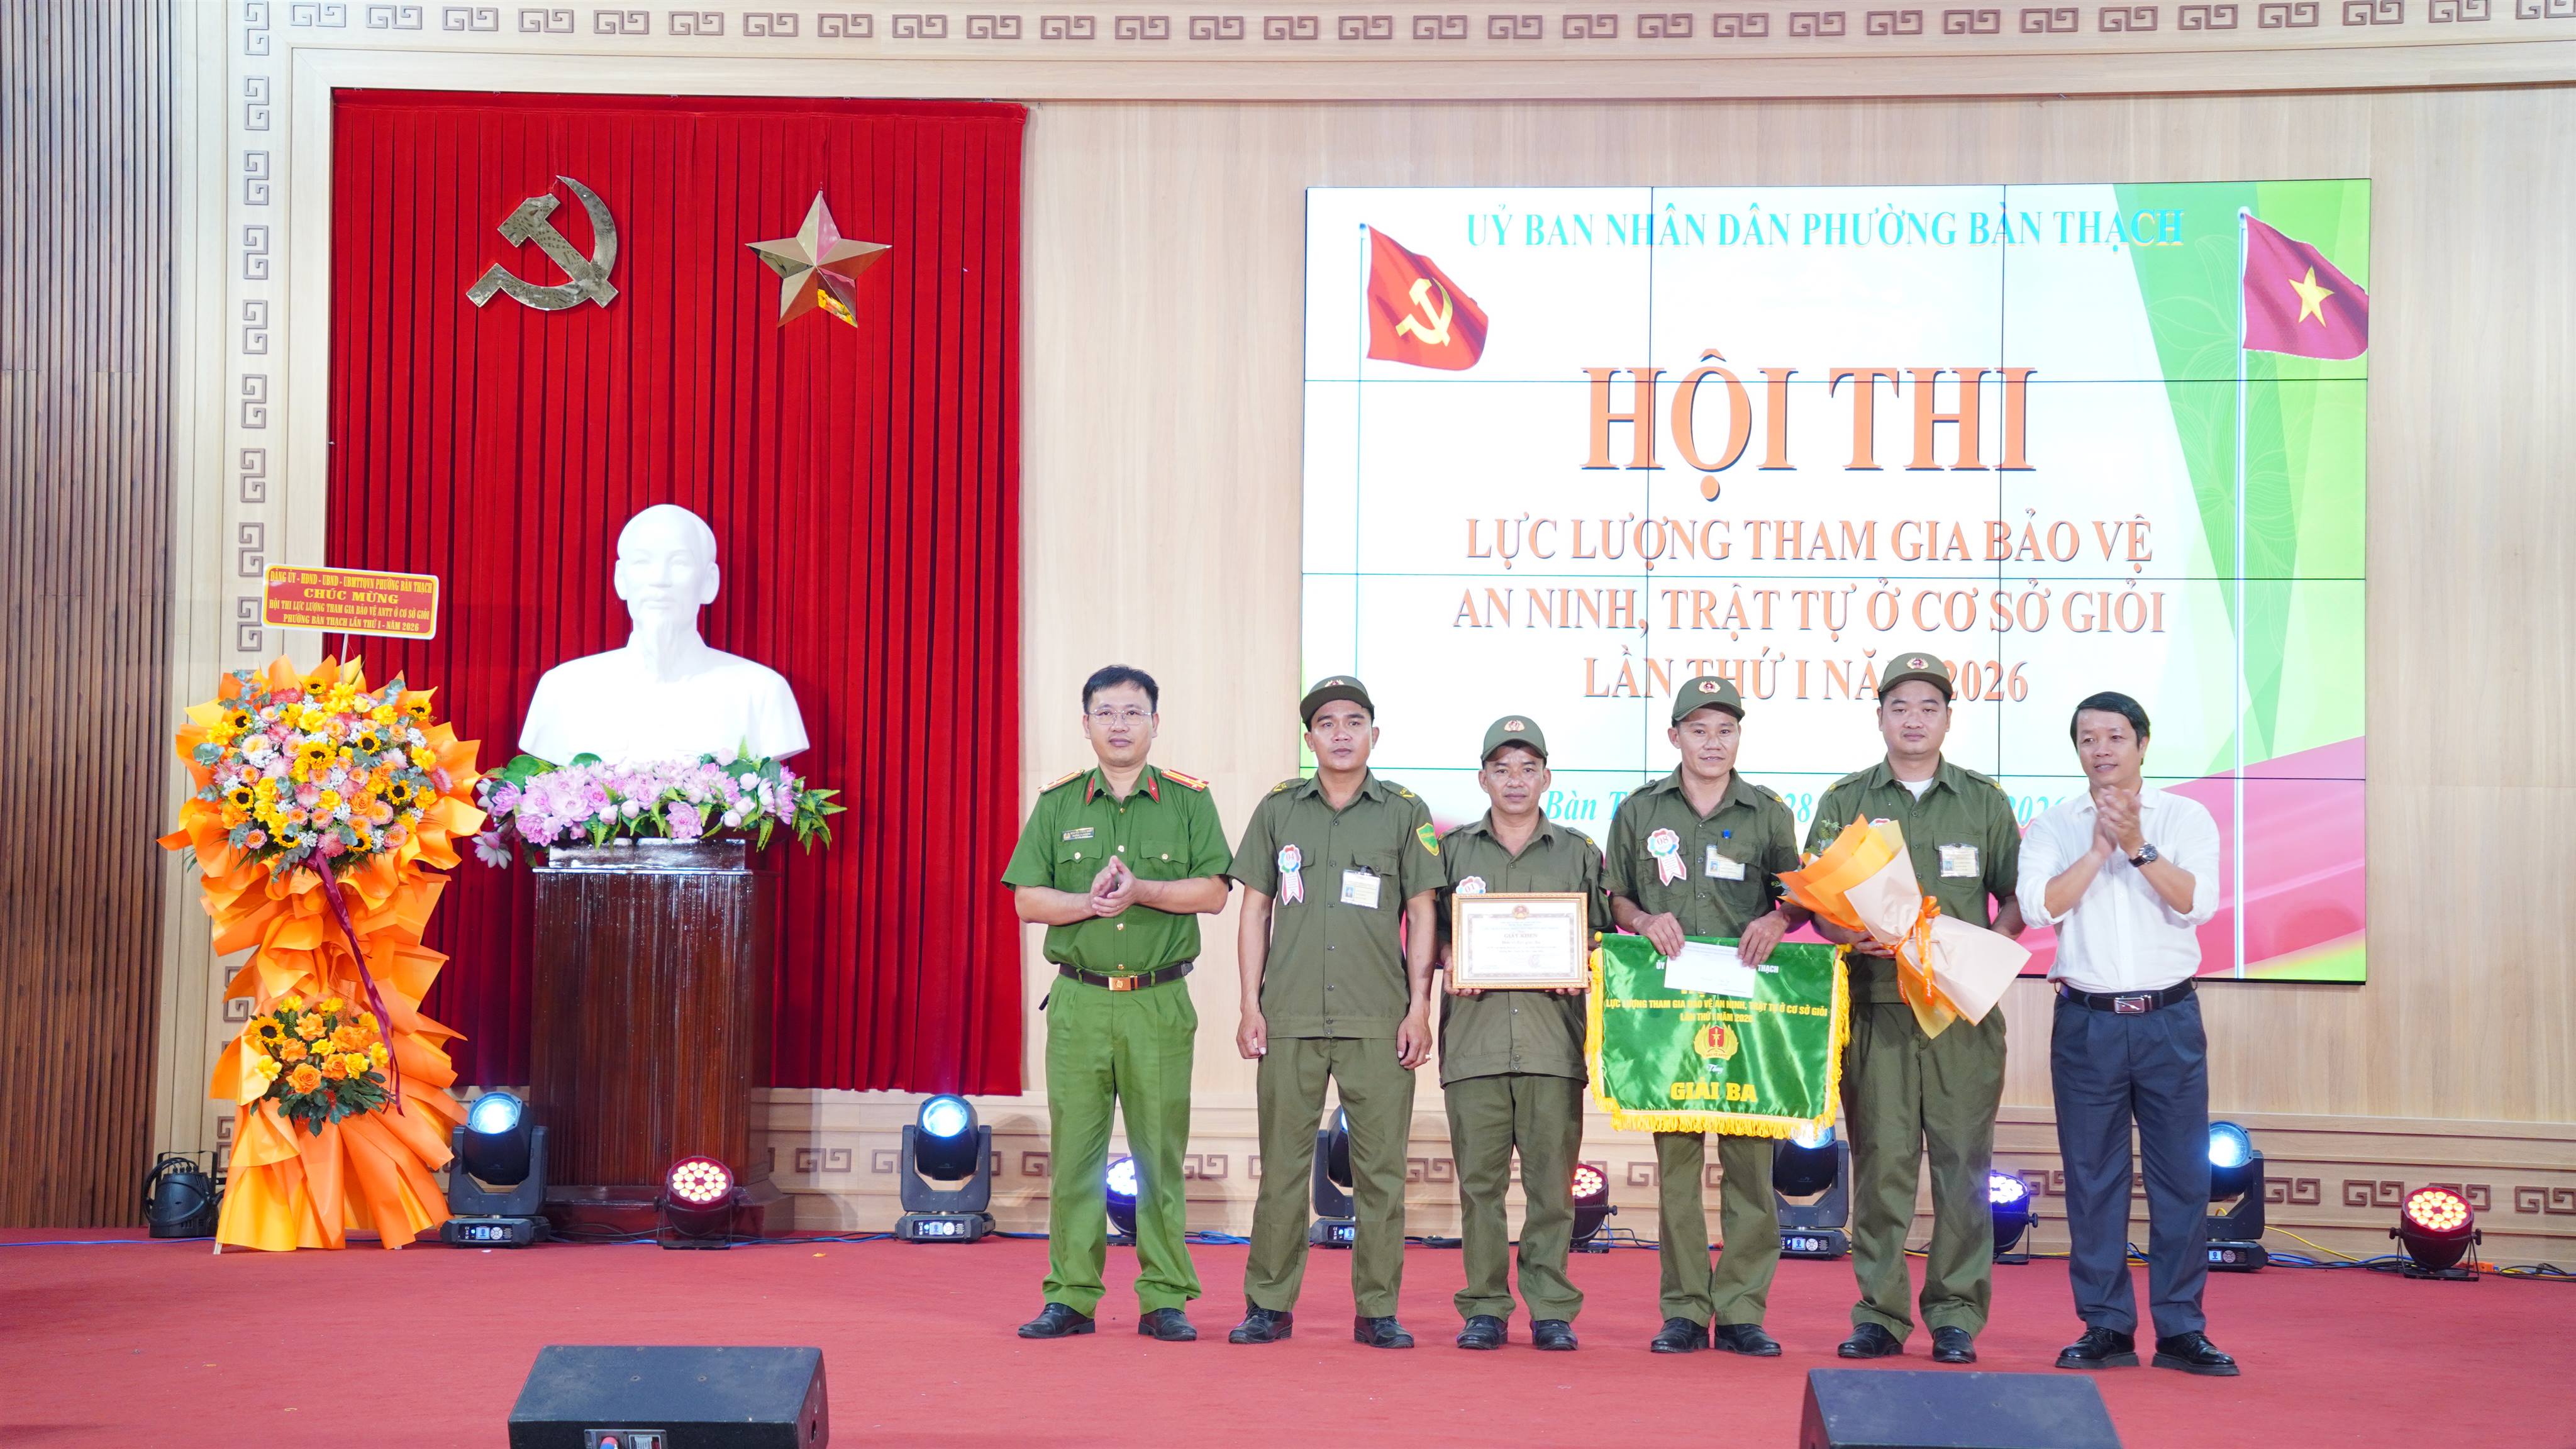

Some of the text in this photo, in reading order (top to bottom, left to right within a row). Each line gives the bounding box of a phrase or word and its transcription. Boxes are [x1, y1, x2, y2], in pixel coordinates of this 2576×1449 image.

[1467, 202, 2185, 255] UỶ BAN NHÂN DÂN PHƯỜNG BÀN THẠCH
[1579, 348, 2037, 502] HỘI THI
[1465, 508, 2153, 574] LỰC LƯỢNG THAM GIA BẢO VỆ
[322, 574, 338, 586] UBND
[375, 577, 399, 591] PHƯỜNG
[401, 579, 413, 592] BÀN
[414, 582, 433, 594] THẠCH
[304, 588, 399, 604] CHÚC MỪNG
[269, 598, 280, 611] HỘI
[281, 599, 292, 610] THI
[293, 601, 304, 612] LỰC
[306, 602, 325, 613] LƯỢNG
[326, 603, 343, 613] THAM
[344, 604, 354, 614] GIA
[356, 604, 368, 615] BẢO
[369, 605, 377, 617] VỆ
[378, 607, 393, 617] ANTT
[399, 608, 408, 618] CƠ
[408, 608, 416, 619] SỞ
[1452, 577, 2165, 642] AN NINH, TRẬT TỰ Ở CƠ SỞ GIỎI
[283, 613, 310, 624] PHƯỜNG
[311, 614, 325, 625] BÀN
[326, 616, 348, 627] THẠCH
[402, 622, 419, 631] 2026
[1584, 644, 1675, 698] LẦN
[1685, 645, 1785, 700] THỨ
[1795, 659, 1810, 700] I
[1823, 647, 1881, 700] NĂ
[1546, 791, 1597, 821] Bàn
[1657, 836, 1669, 845] 08
[1465, 884, 1475, 893] 01
[1758, 964, 1779, 974] THẠCH
[1606, 999, 1621, 1009] LỰC
[1649, 999, 1671, 1009] THAM
[1672, 999, 1685, 1008] GIA
[1786, 1004, 1798, 1014] CƠ
[1799, 1004, 1811, 1015] SỞ
[1670, 1076, 1758, 1103] GIẢI BA
